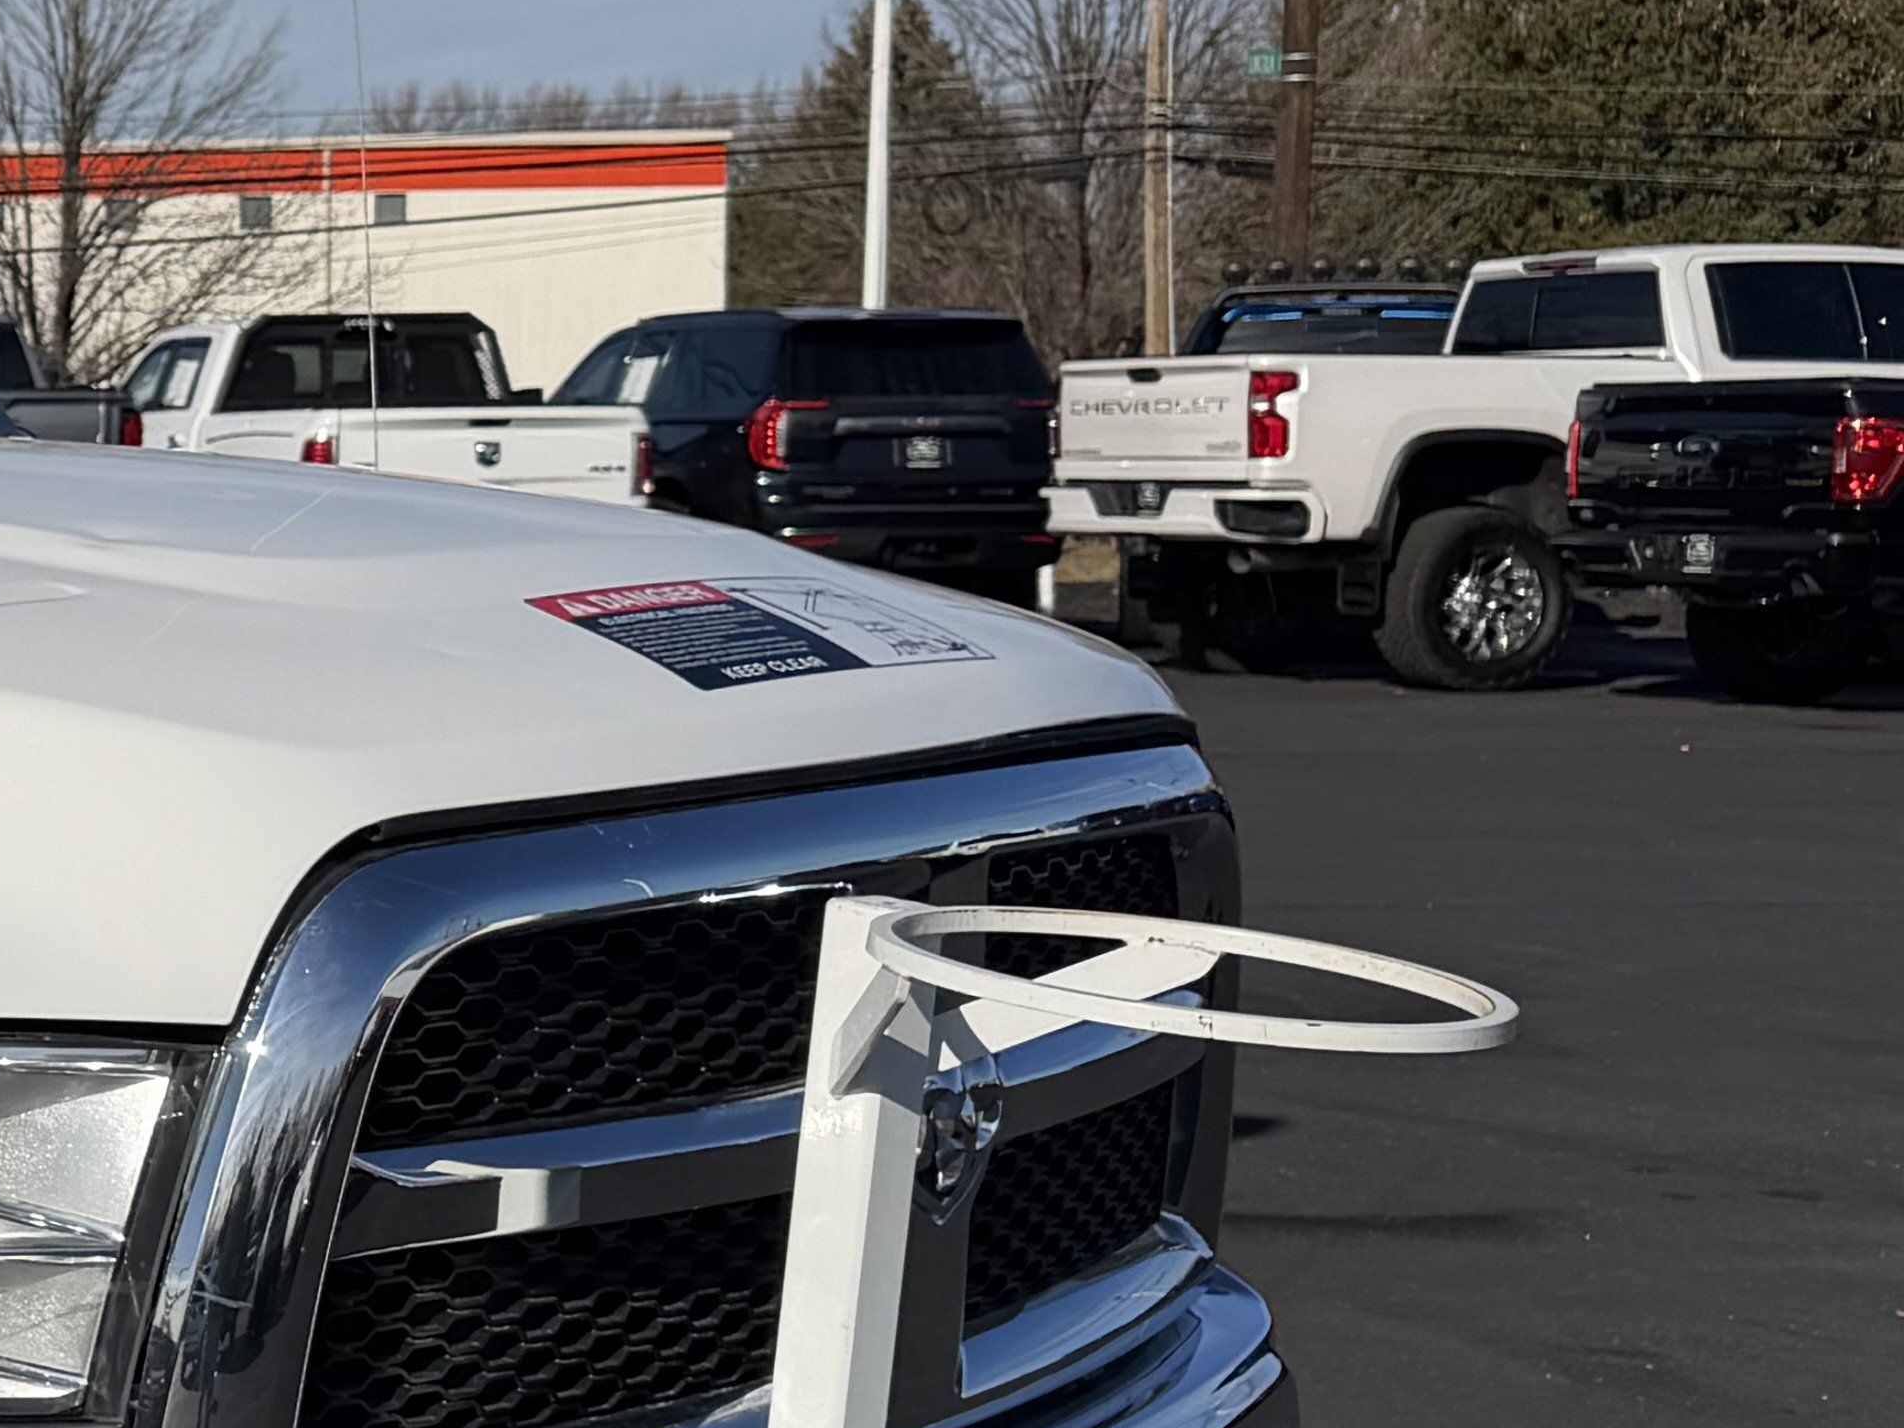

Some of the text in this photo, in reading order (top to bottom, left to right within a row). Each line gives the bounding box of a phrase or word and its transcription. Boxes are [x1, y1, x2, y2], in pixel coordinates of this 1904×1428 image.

[1069, 396, 1230, 416] CHEVROLET
[594, 584, 714, 609] DANGER
[720, 655, 829, 680] KEEP CLEAR
